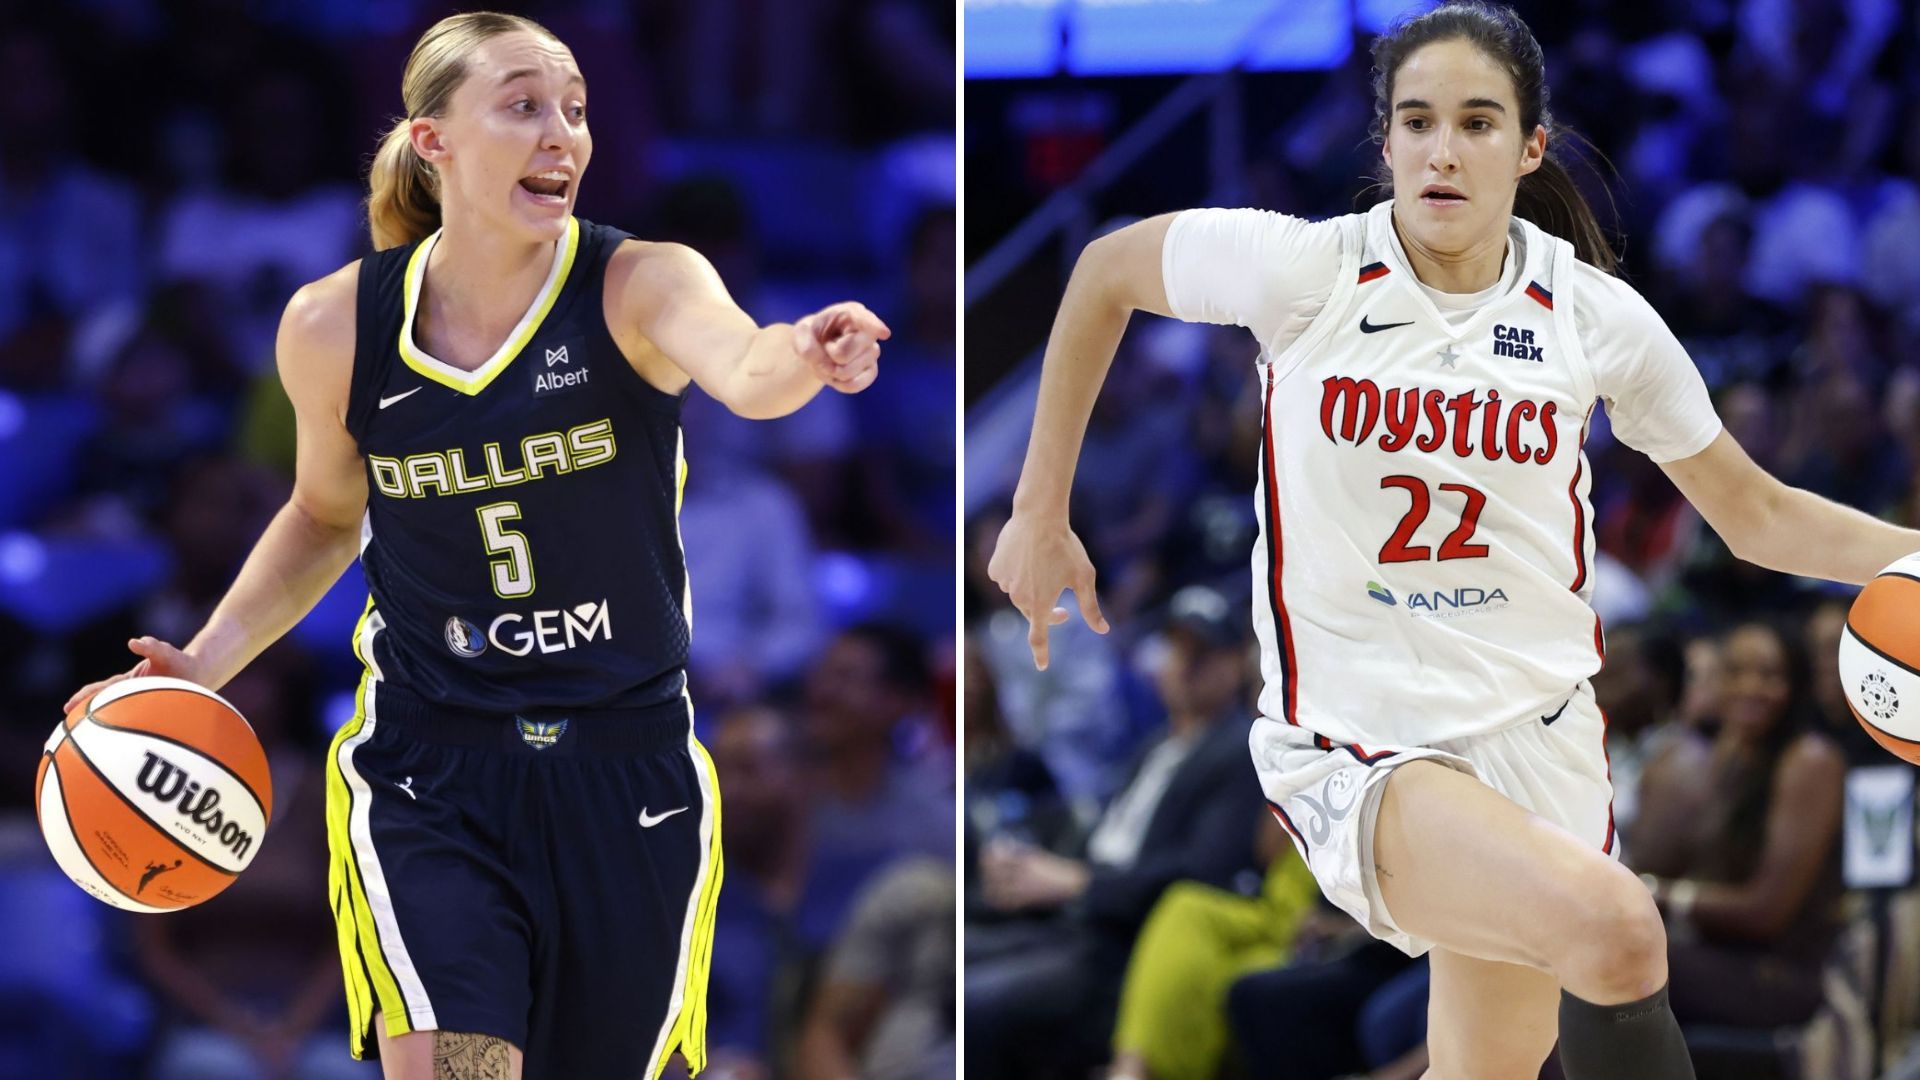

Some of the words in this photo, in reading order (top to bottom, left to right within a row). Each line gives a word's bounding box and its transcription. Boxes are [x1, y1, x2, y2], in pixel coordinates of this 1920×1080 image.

[1493, 324, 1535, 345] CAR
[1493, 340, 1544, 362] max
[535, 367, 589, 392] Albert
[369, 418, 617, 499] DALLAS
[475, 501, 536, 599] 5
[1379, 475, 1489, 564] 22
[488, 599, 612, 657] GEM
[136, 750, 252, 861] Wilson
